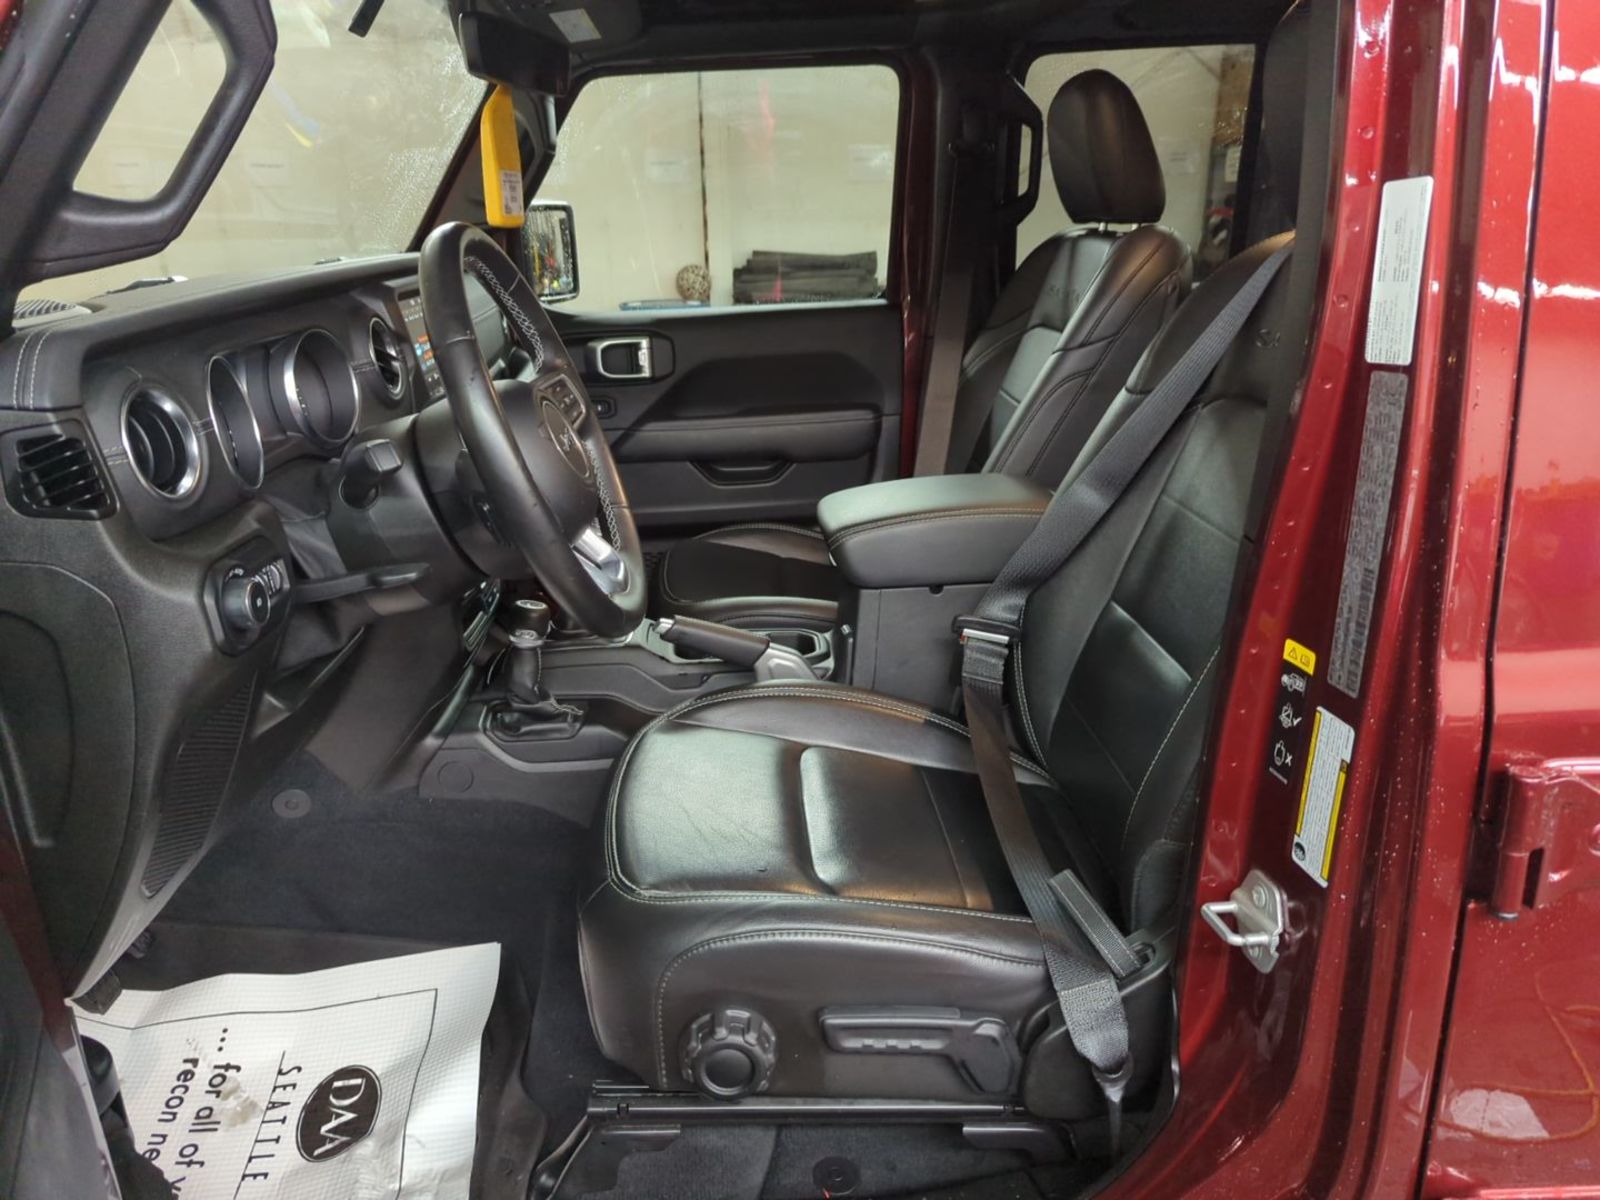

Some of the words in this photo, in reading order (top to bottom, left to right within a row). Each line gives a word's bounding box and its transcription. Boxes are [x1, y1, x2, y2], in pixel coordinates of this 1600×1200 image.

[157, 1058, 200, 1123] recon
[205, 1062, 242, 1099] for
[188, 1106, 222, 1133] all
[241, 1066, 302, 1182] SEATTLE
[313, 1078, 366, 1157] DAA
[142, 1133, 168, 1161] ne
[175, 1143, 206, 1168] of
